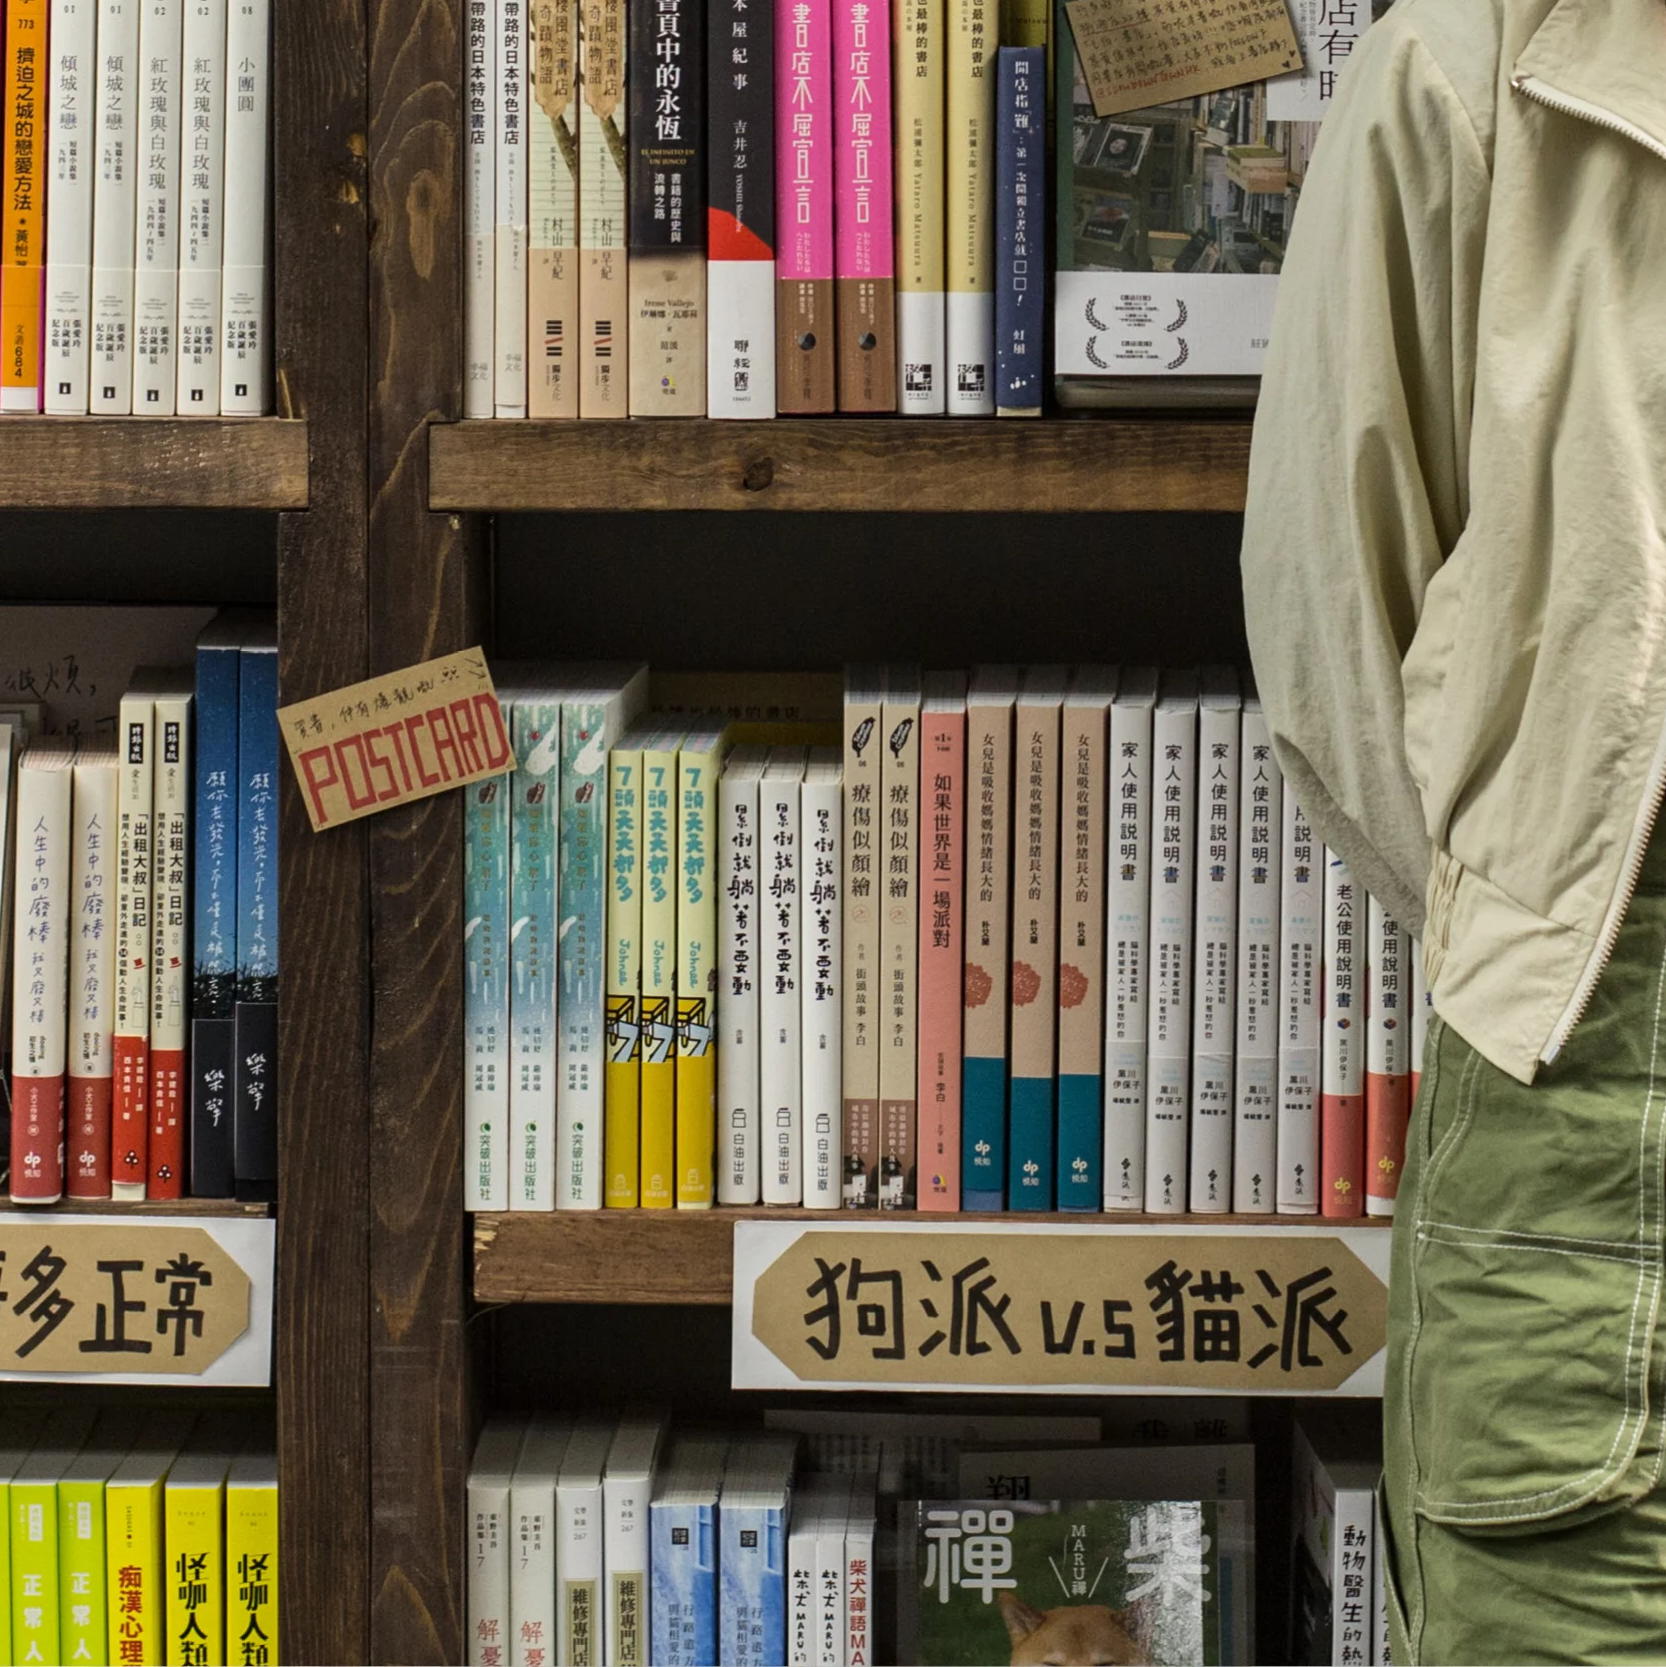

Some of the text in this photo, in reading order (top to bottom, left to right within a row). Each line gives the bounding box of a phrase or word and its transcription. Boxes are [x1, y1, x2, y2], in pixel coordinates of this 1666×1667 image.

[13, 47, 35, 212] 擠迫之城的戀愛方法
[59, 56, 77, 131] 傾城之戀
[149, 56, 169, 191] 紅玫瑰與白玫瑰
[238, 57, 255, 112] 小團圓
[734, 120, 746, 169] 吉井忍
[791, 3, 814, 224] 書店不屈宣言
[850, 3, 872, 224] 書店不屈宣言
[299, 692, 513, 823] POSTCARD
[981, 733, 994, 902] 女兒是吸收媽媽情緒長大的
[851, 783, 871, 898] 療傷似顏繪
[932, 774, 952, 948] 如果世界是一場派對
[924, 1508, 1017, 1604] 禪
